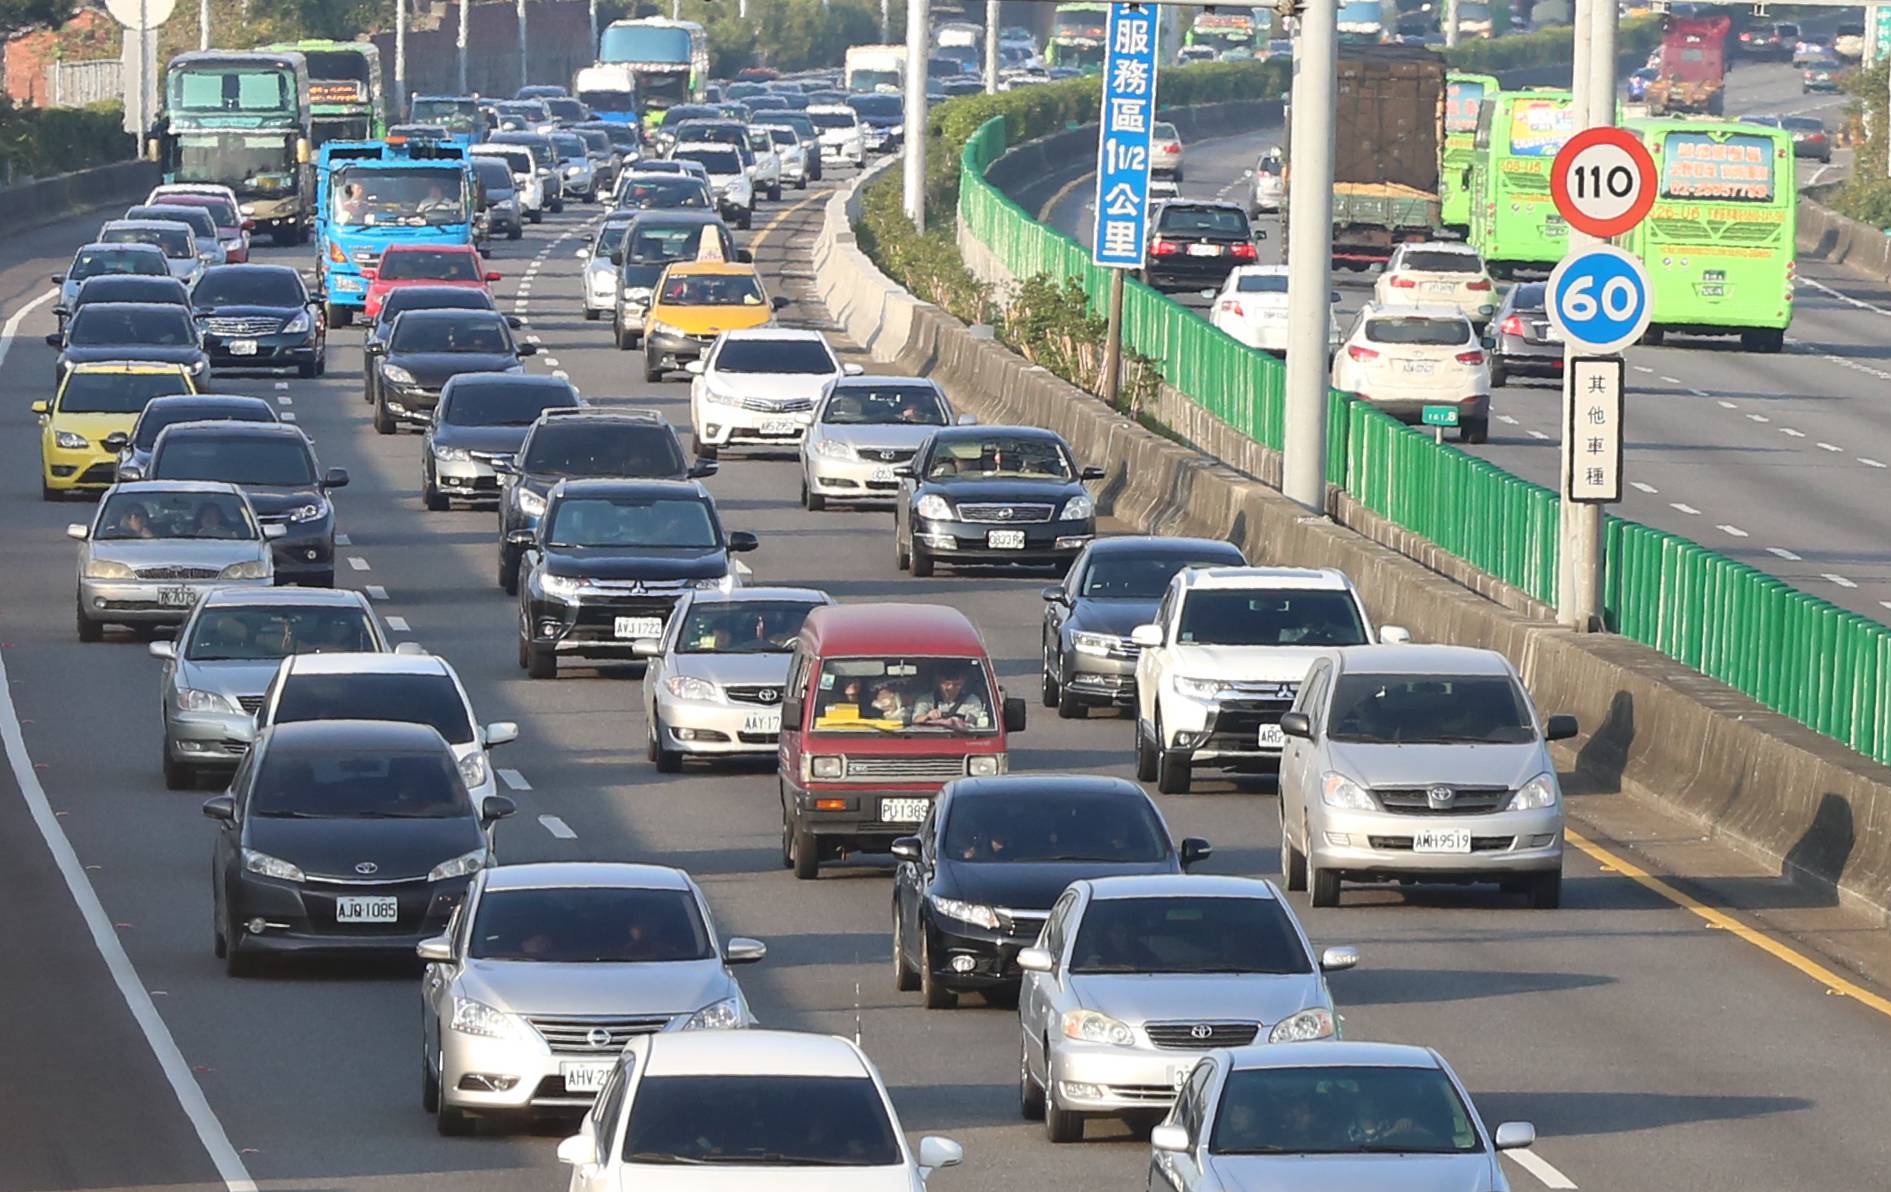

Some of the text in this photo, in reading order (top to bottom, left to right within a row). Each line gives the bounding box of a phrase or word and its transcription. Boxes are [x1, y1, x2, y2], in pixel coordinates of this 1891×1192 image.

[1575, 165, 1634, 199] 110
[1562, 275, 1639, 323] 60
[1585, 375, 1607, 486] 其他車種
